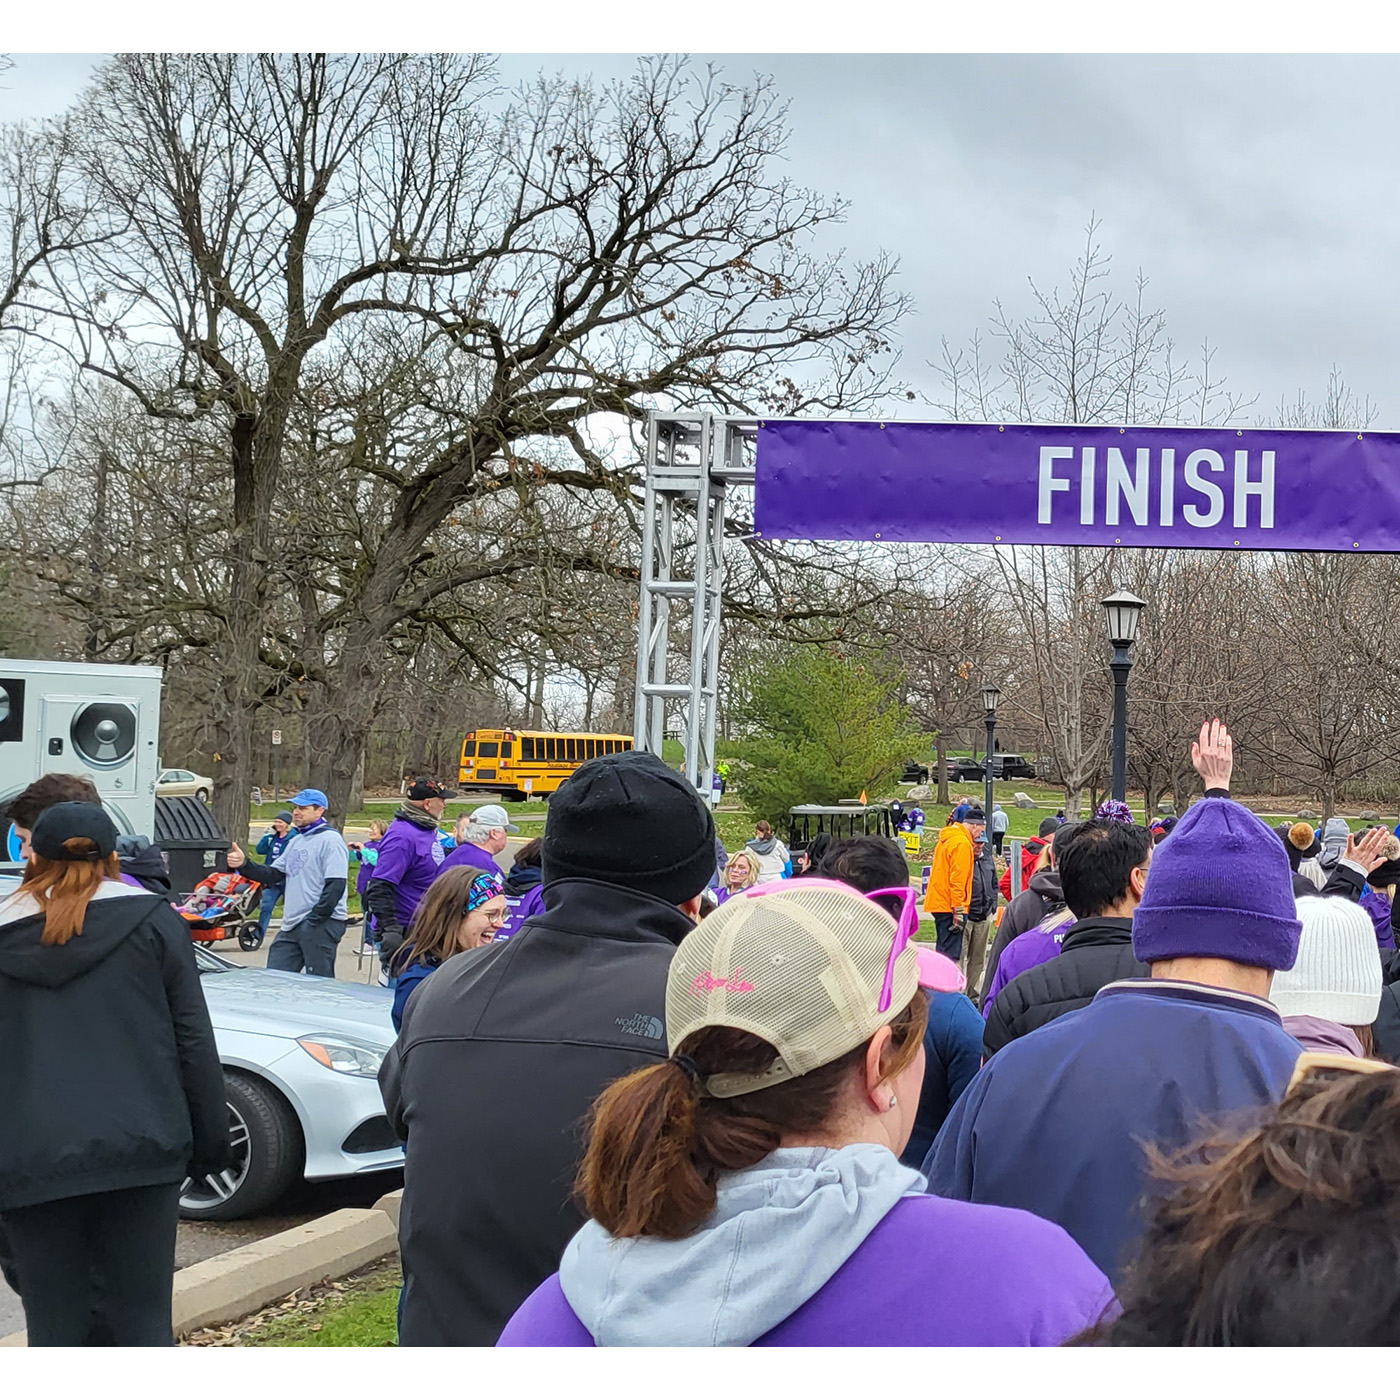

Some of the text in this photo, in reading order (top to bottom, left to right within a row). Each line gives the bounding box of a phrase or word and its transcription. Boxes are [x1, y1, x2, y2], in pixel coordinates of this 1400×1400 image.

[1038, 446, 1276, 529] FINISH
[633, 1013, 651, 1021] THE
[615, 1017, 649, 1030] NORTH
[621, 1026, 644, 1036] FACE
